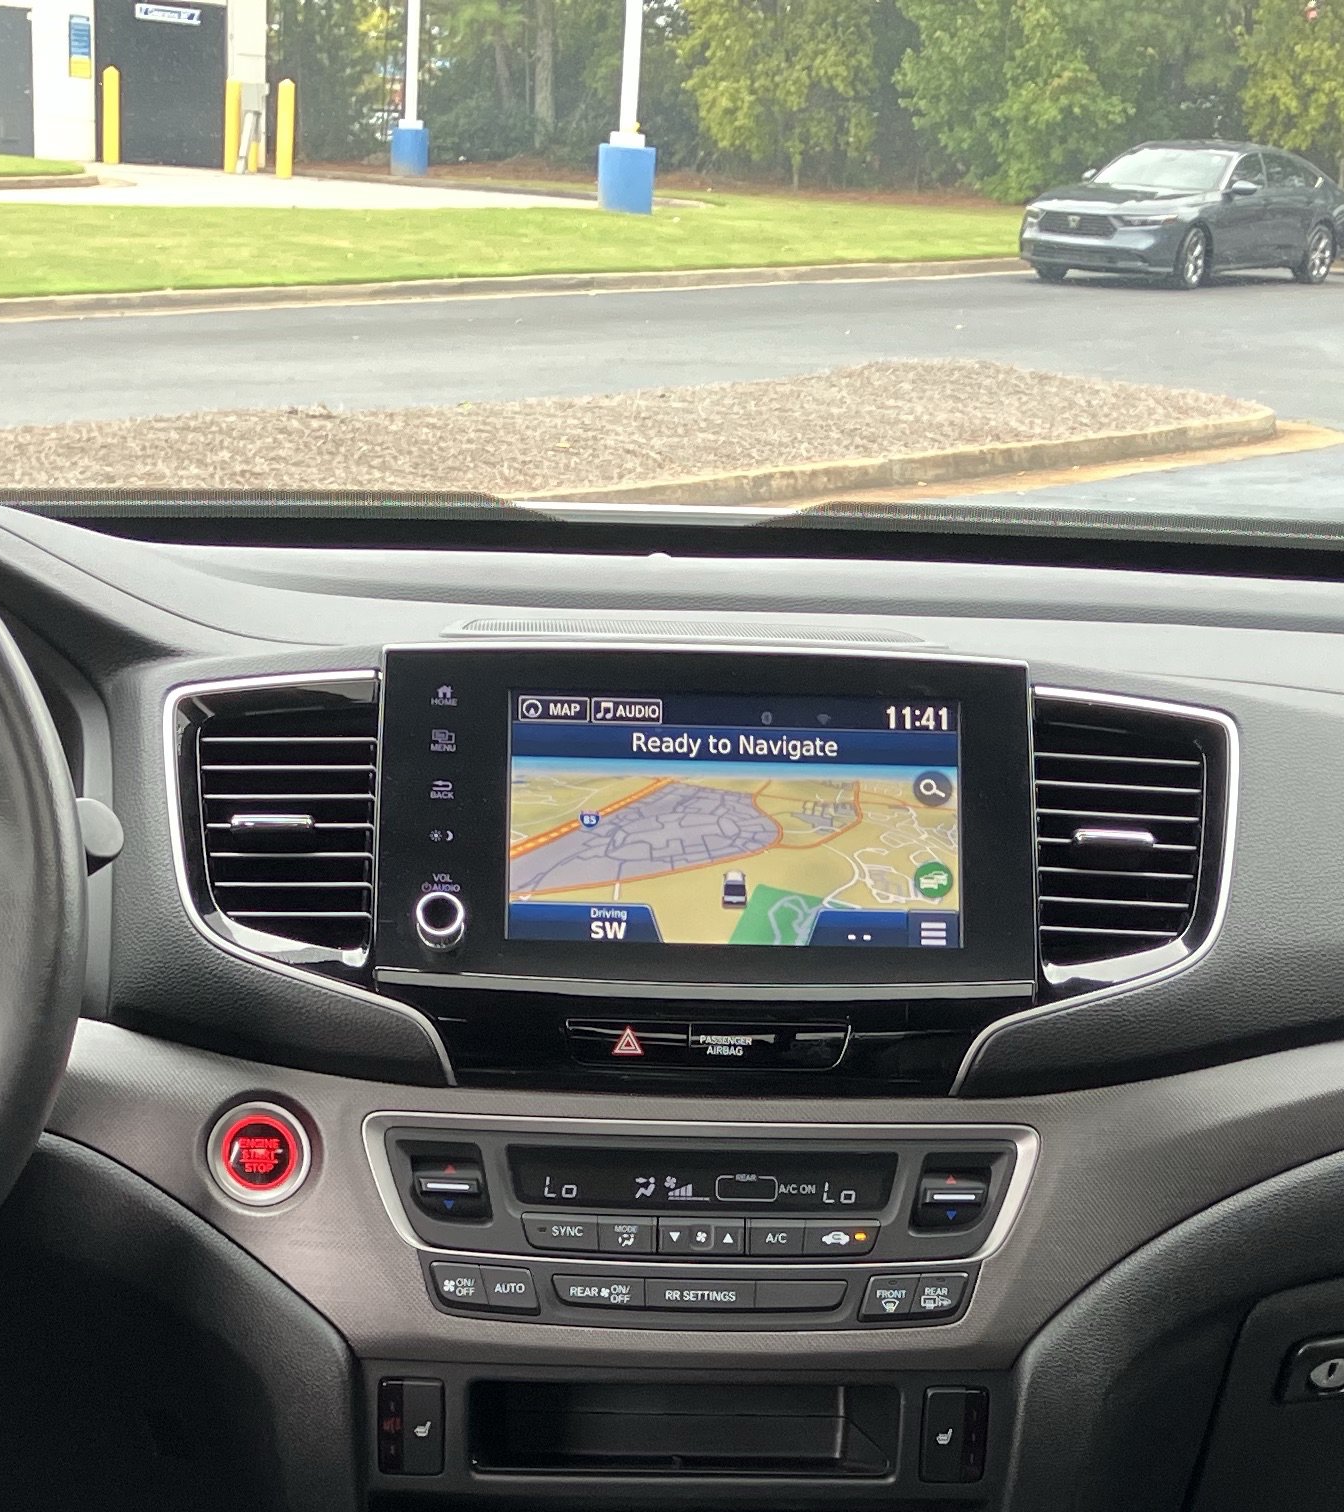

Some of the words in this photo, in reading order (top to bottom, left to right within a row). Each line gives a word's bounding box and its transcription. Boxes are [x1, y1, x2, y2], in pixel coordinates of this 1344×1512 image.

[430, 698, 458, 706] HOME
[549, 702, 581, 716] MAP
[616, 704, 660, 719] AUDIO
[885, 705, 949, 731] 11:41
[430, 743, 457, 753] MENU
[632, 733, 702, 759] Ready
[709, 734, 731, 754] to
[739, 735, 838, 761] Navigate
[430, 790, 455, 800] BACK
[582, 815, 597, 825] 85
[432, 873, 453, 883] VOL
[432, 883, 461, 893] AUDIO
[590, 907, 628, 921] Driving
[590, 920, 627, 940] SW
[699, 1034, 753, 1047] PASSENGER
[706, 1045, 744, 1056] AIRBAG
[238, 1137, 281, 1149] ENGINE
[242, 1149, 277, 1161] START
[244, 1163, 275, 1173] STOP
[735, 1173, 757, 1182] REAR
[544, 1176, 578, 1199] Lo
[778, 1183, 798, 1194] A/C
[800, 1184, 816, 1195] ON
[822, 1181, 856, 1204] Lo
[551, 1225, 584, 1238] SYNC
[614, 1225, 638, 1233] MODE
[765, 1232, 788, 1244] A/C
[455, 1277, 476, 1287] ON/
[494, 1282, 526, 1294] AUTO
[455, 1287, 476, 1297] OFF
[569, 1286, 599, 1298] REAR
[610, 1284, 631, 1294] ON/
[876, 1289, 907, 1299] FRONT
[924, 1287, 948, 1296] REAR
[610, 1294, 632, 1304] OFF
[665, 1290, 681, 1301] RR
[683, 1290, 736, 1302] SETTINGS
